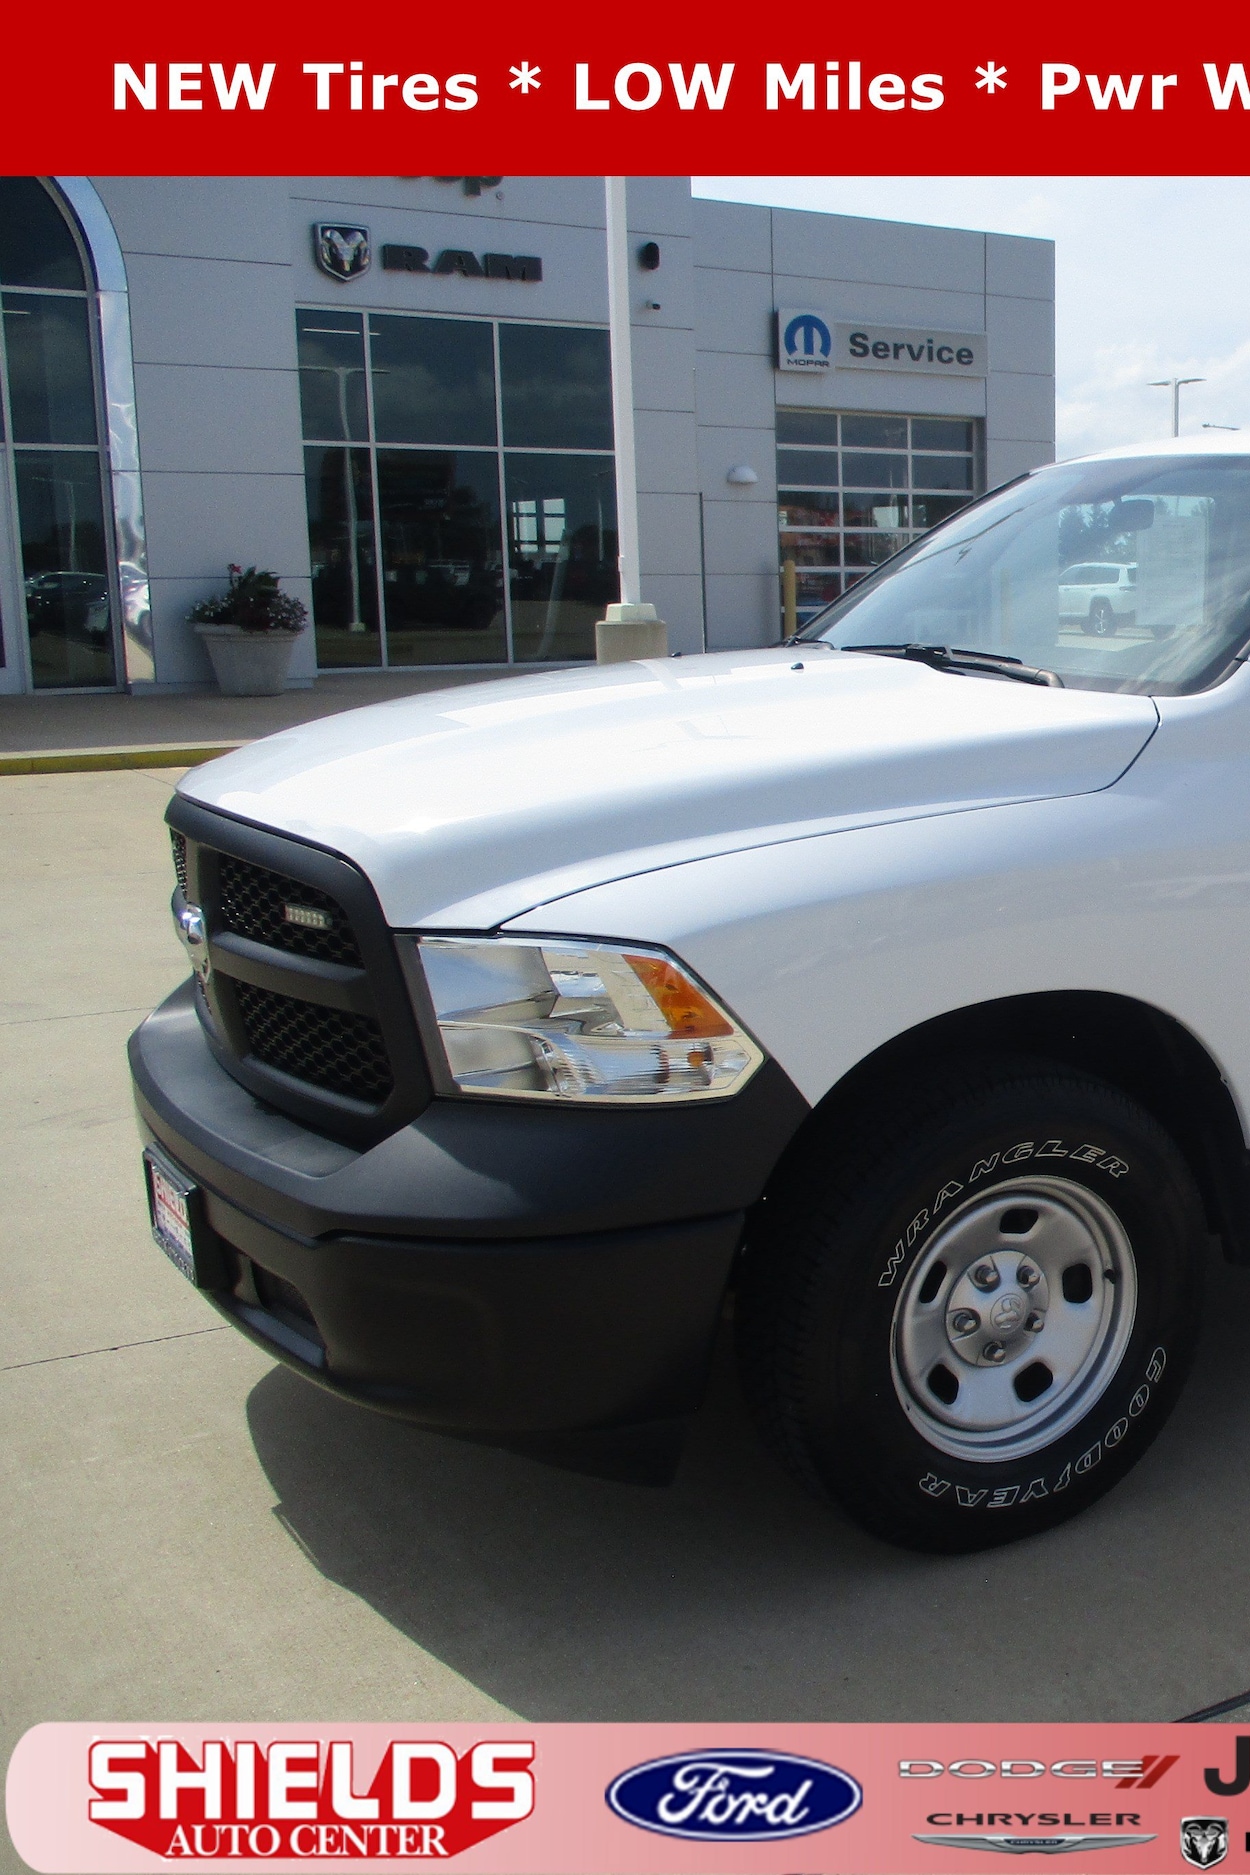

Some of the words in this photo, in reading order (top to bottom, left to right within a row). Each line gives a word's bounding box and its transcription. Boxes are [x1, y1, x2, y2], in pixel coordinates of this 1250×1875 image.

[382, 243, 543, 282] RAM
[786, 357, 831, 369] MOPAR
[849, 331, 975, 366] Service
[878, 1139, 1130, 1287] WRANGLER
